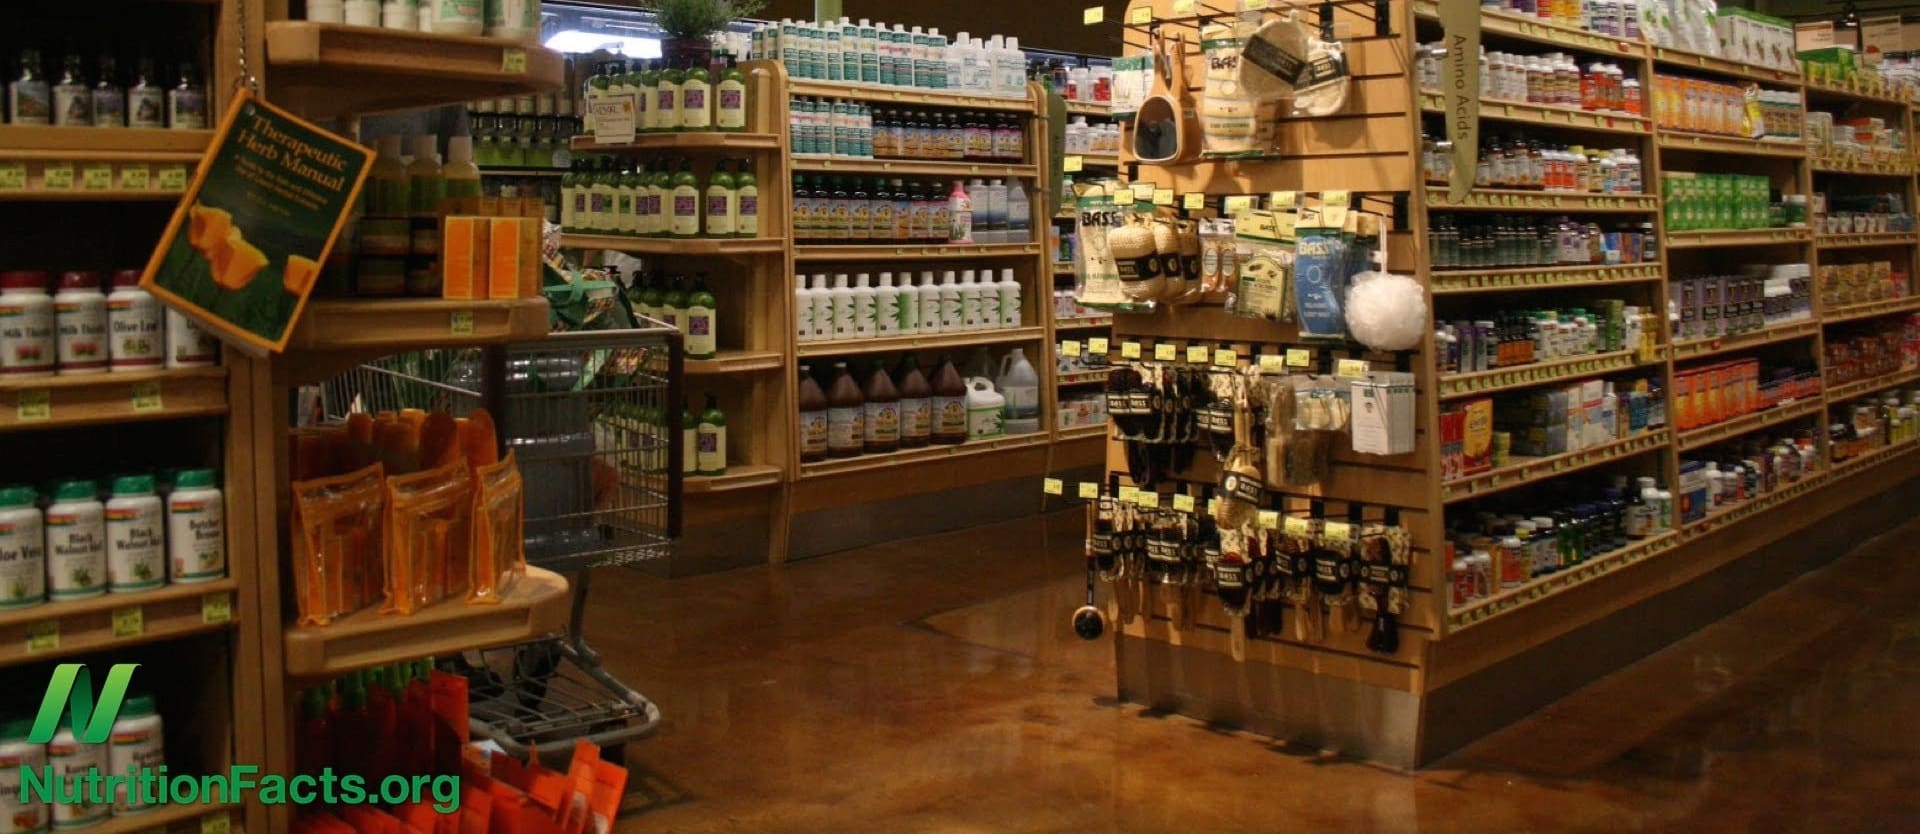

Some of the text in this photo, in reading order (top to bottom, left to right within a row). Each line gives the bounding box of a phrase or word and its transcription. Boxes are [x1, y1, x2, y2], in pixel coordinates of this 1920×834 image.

[1453, 34, 1472, 141] Amino Acids
[253, 116, 348, 172] Therapeutic
[237, 127, 278, 161] Herb
[279, 151, 346, 193] Manual
[1081, 210, 1119, 227] BASS
[1299, 241, 1330, 256] BASS
[114, 320, 138, 331] Olive
[69, 533, 93, 545] Black
[130, 528, 152, 540] Black
[55, 544, 89, 555] Walnut
[116, 539, 148, 551] Walnut
[0, 549, 18, 561] loe
